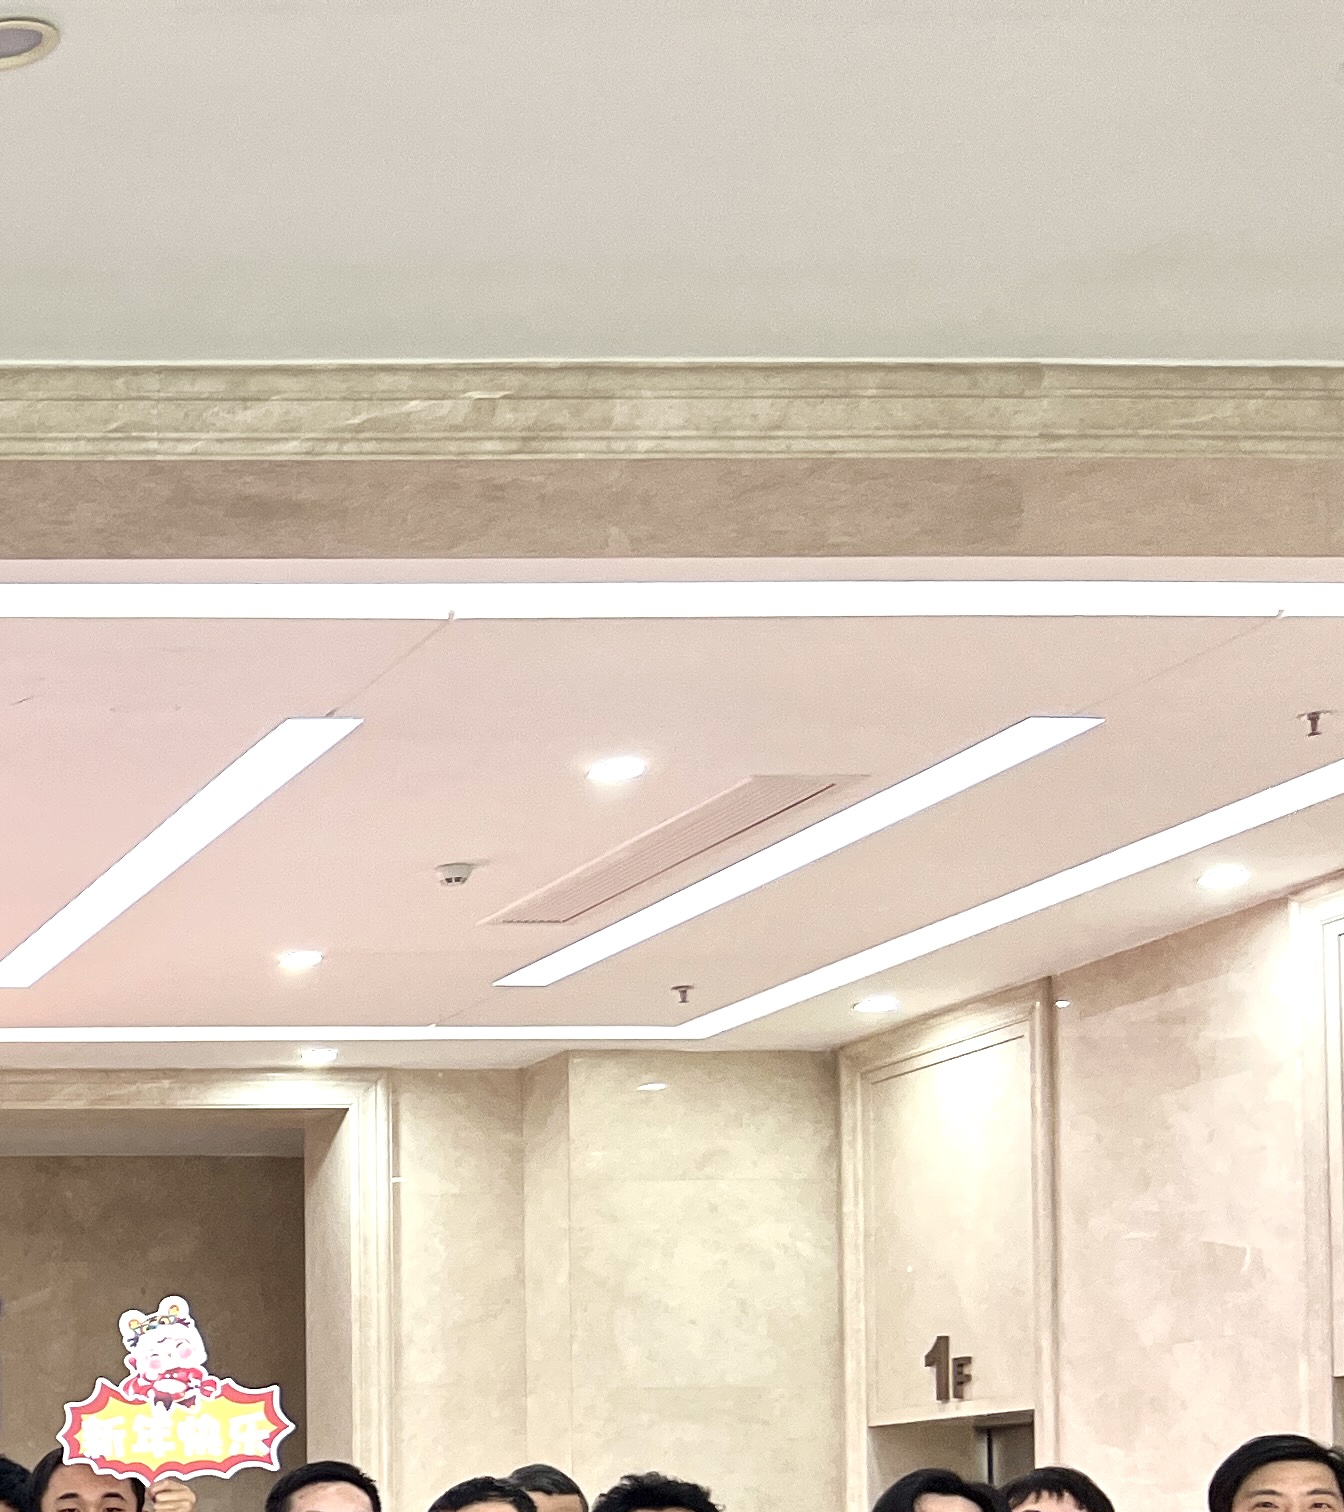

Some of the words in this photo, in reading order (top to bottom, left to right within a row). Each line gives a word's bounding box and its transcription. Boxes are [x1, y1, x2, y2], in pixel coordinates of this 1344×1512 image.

[924, 1335, 973, 1402] 1F
[81, 1412, 271, 1459] 新年快乐
